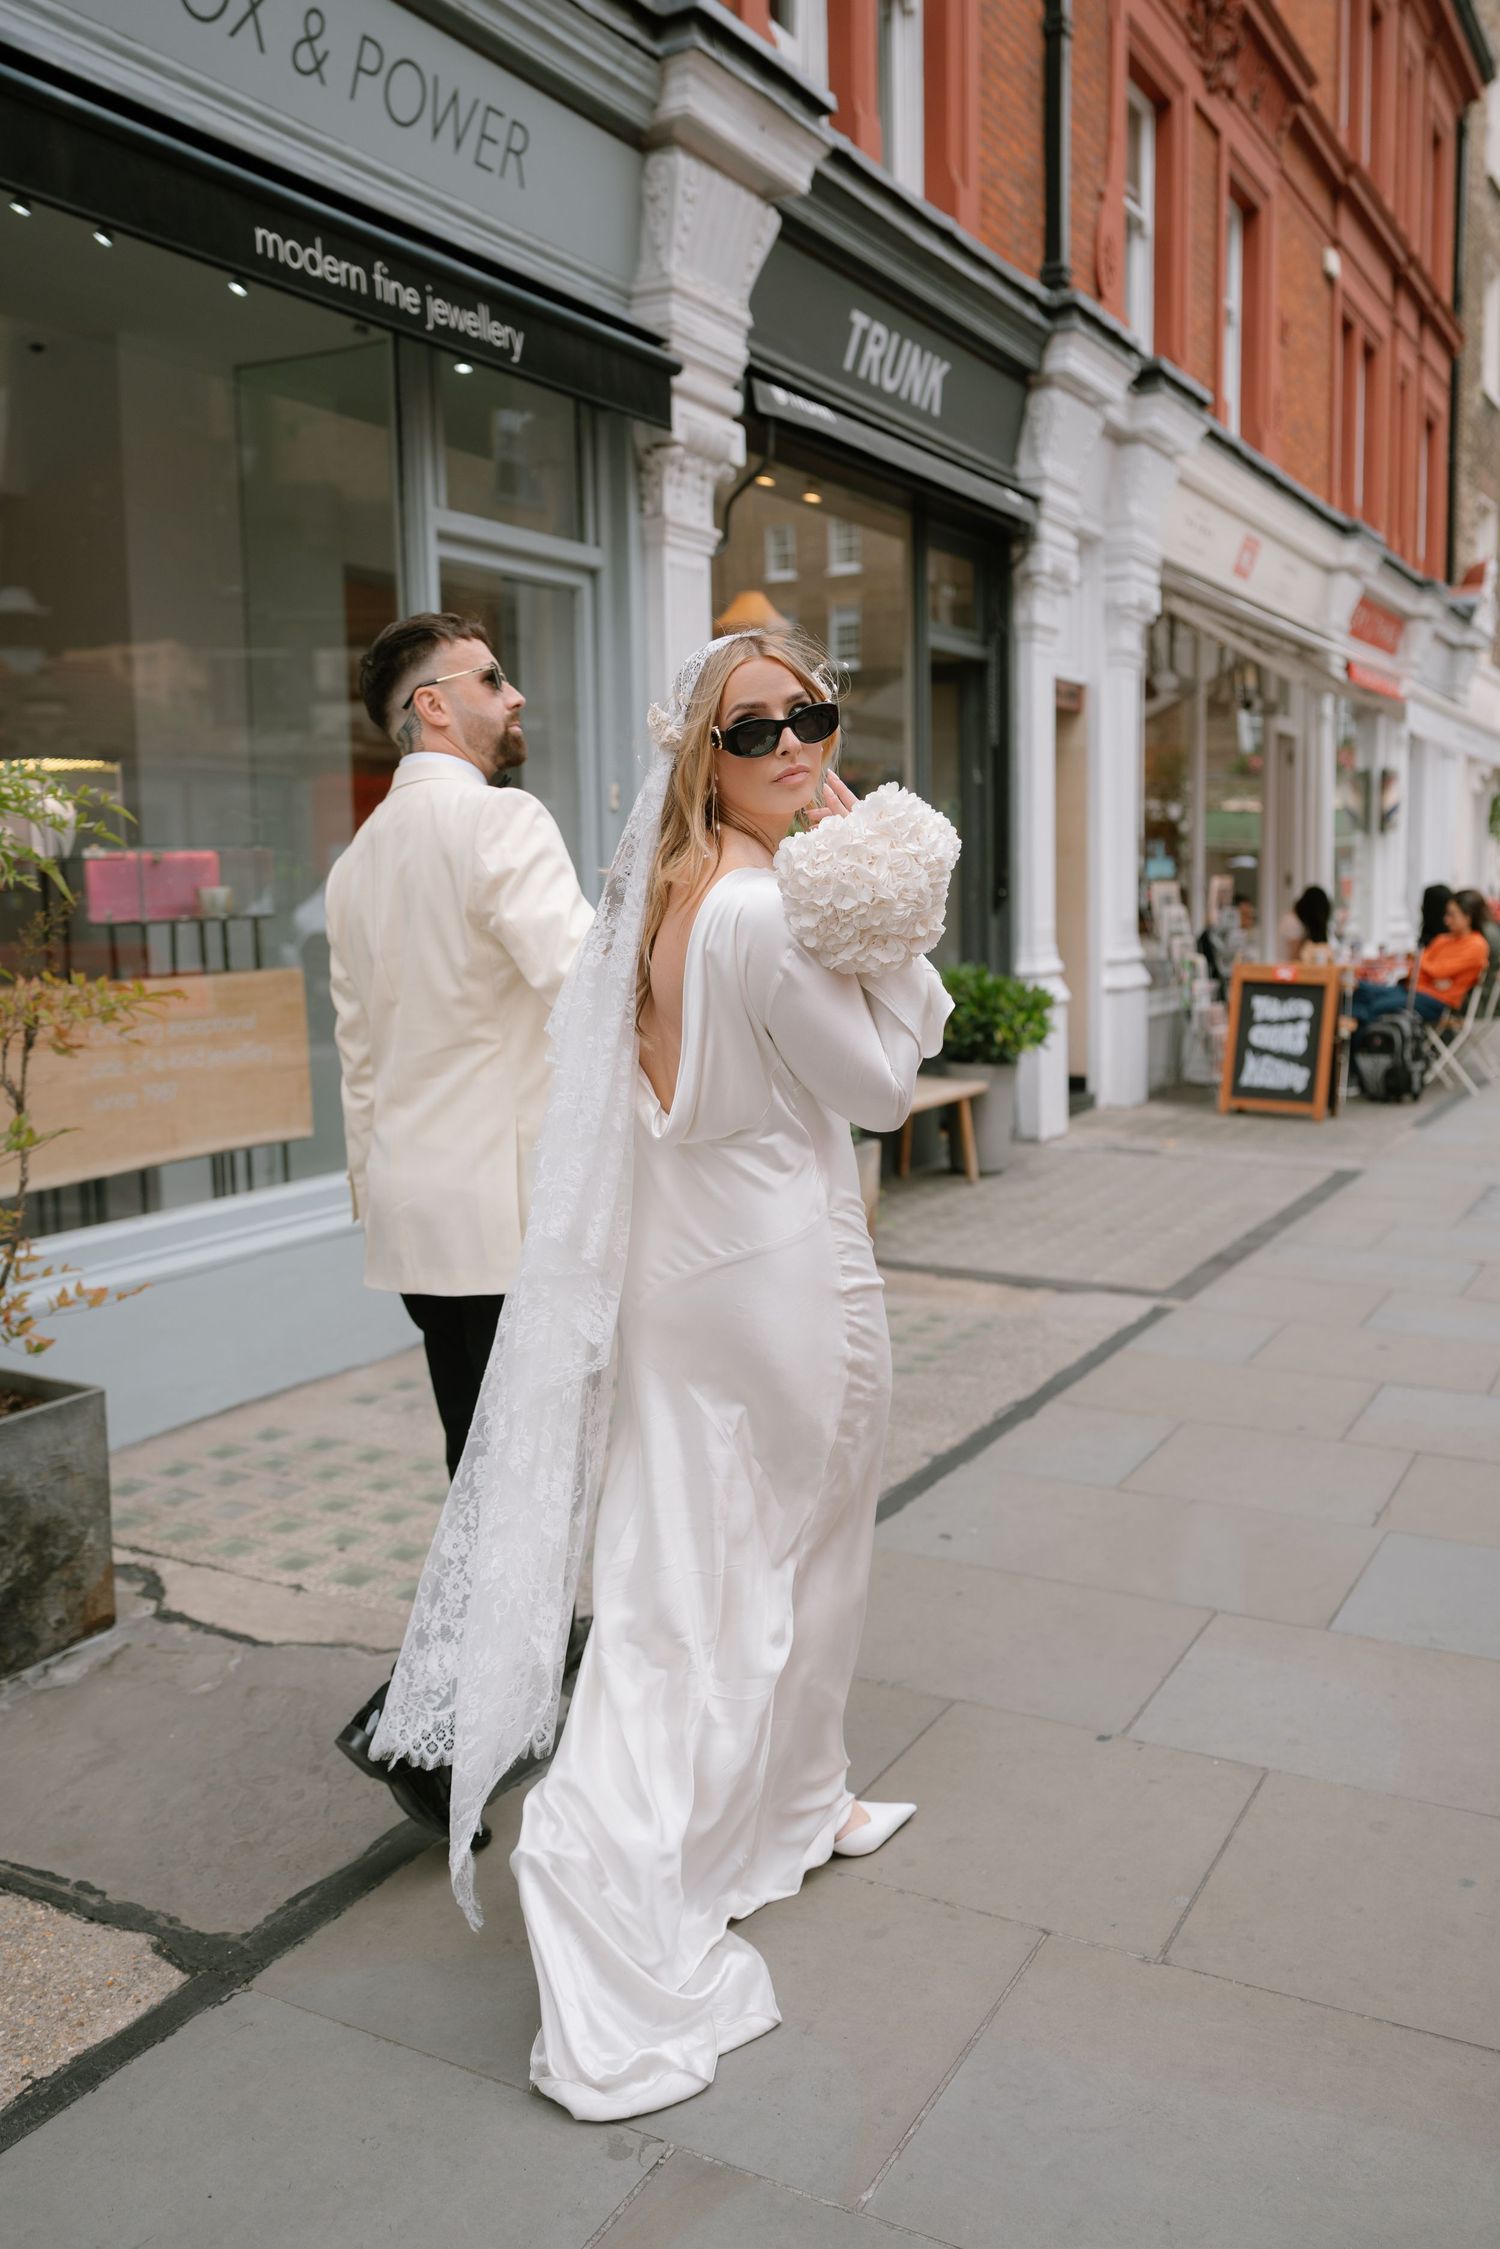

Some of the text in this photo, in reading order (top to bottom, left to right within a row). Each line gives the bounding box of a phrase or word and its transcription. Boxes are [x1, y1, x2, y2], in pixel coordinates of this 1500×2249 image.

[292, 5, 330, 86] &
[350, 33, 531, 190] POWER
[254, 226, 525, 364] modern fine jewellery
[842, 308, 952, 417] TRUNK
